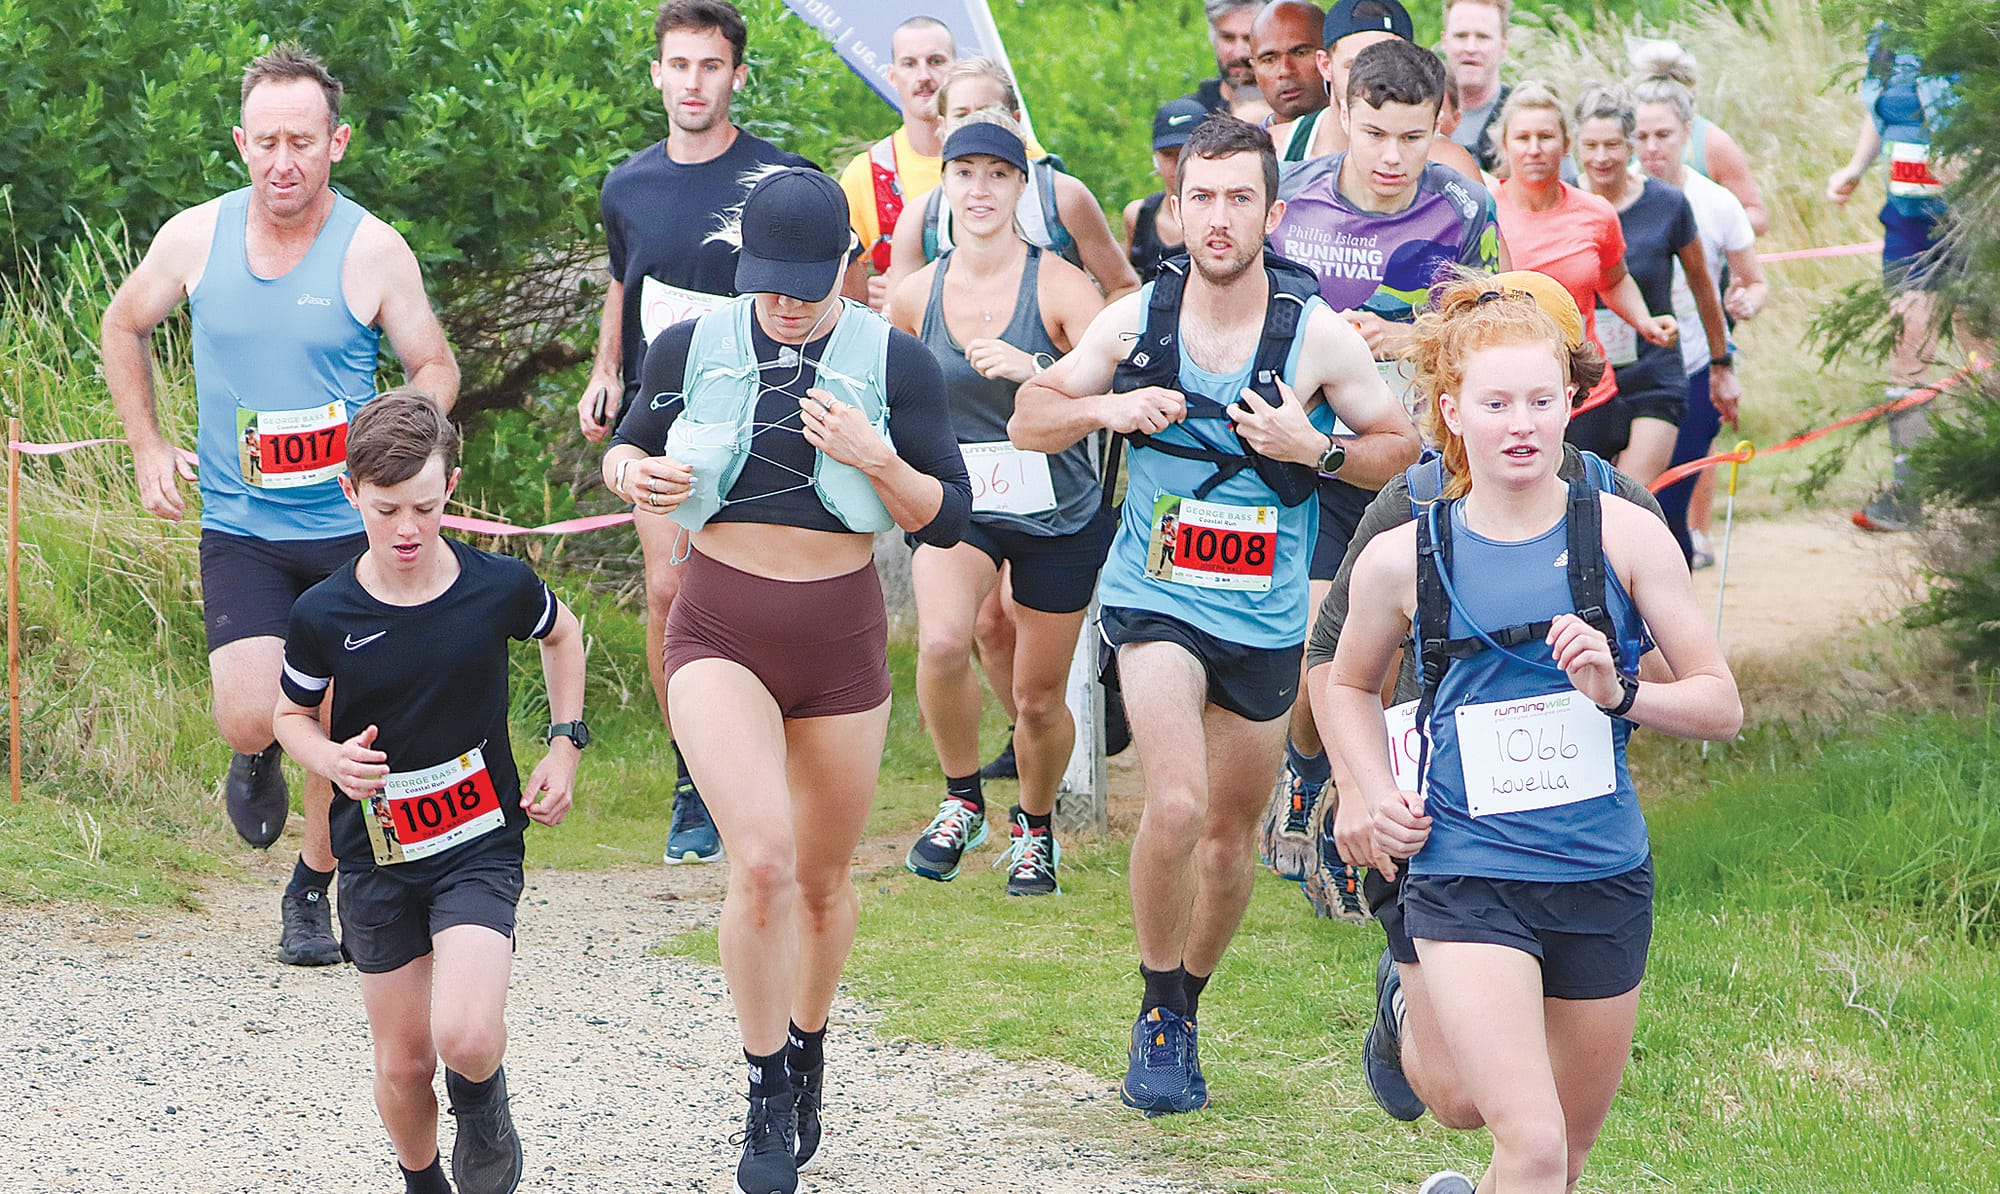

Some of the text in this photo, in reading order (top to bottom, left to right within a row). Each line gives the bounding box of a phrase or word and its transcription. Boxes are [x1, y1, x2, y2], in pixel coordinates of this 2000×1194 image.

[1287, 224, 1378, 248] Phillip Island
[1284, 239, 1383, 266] RUNNING
[263, 413, 325, 425] GEORGE BASS
[269, 429, 336, 465] 1017
[1185, 505, 1252, 521] GEORGE BASS
[1199, 516, 1223, 525] Coastal
[1182, 527, 1266, 566] 1008
[1494, 696, 1571, 717] runningwild
[1496, 724, 1579, 763] 1066
[388, 766, 458, 789] GEORGE BASS
[405, 780, 445, 794] Coastal Run
[400, 780, 480, 832] 1018
